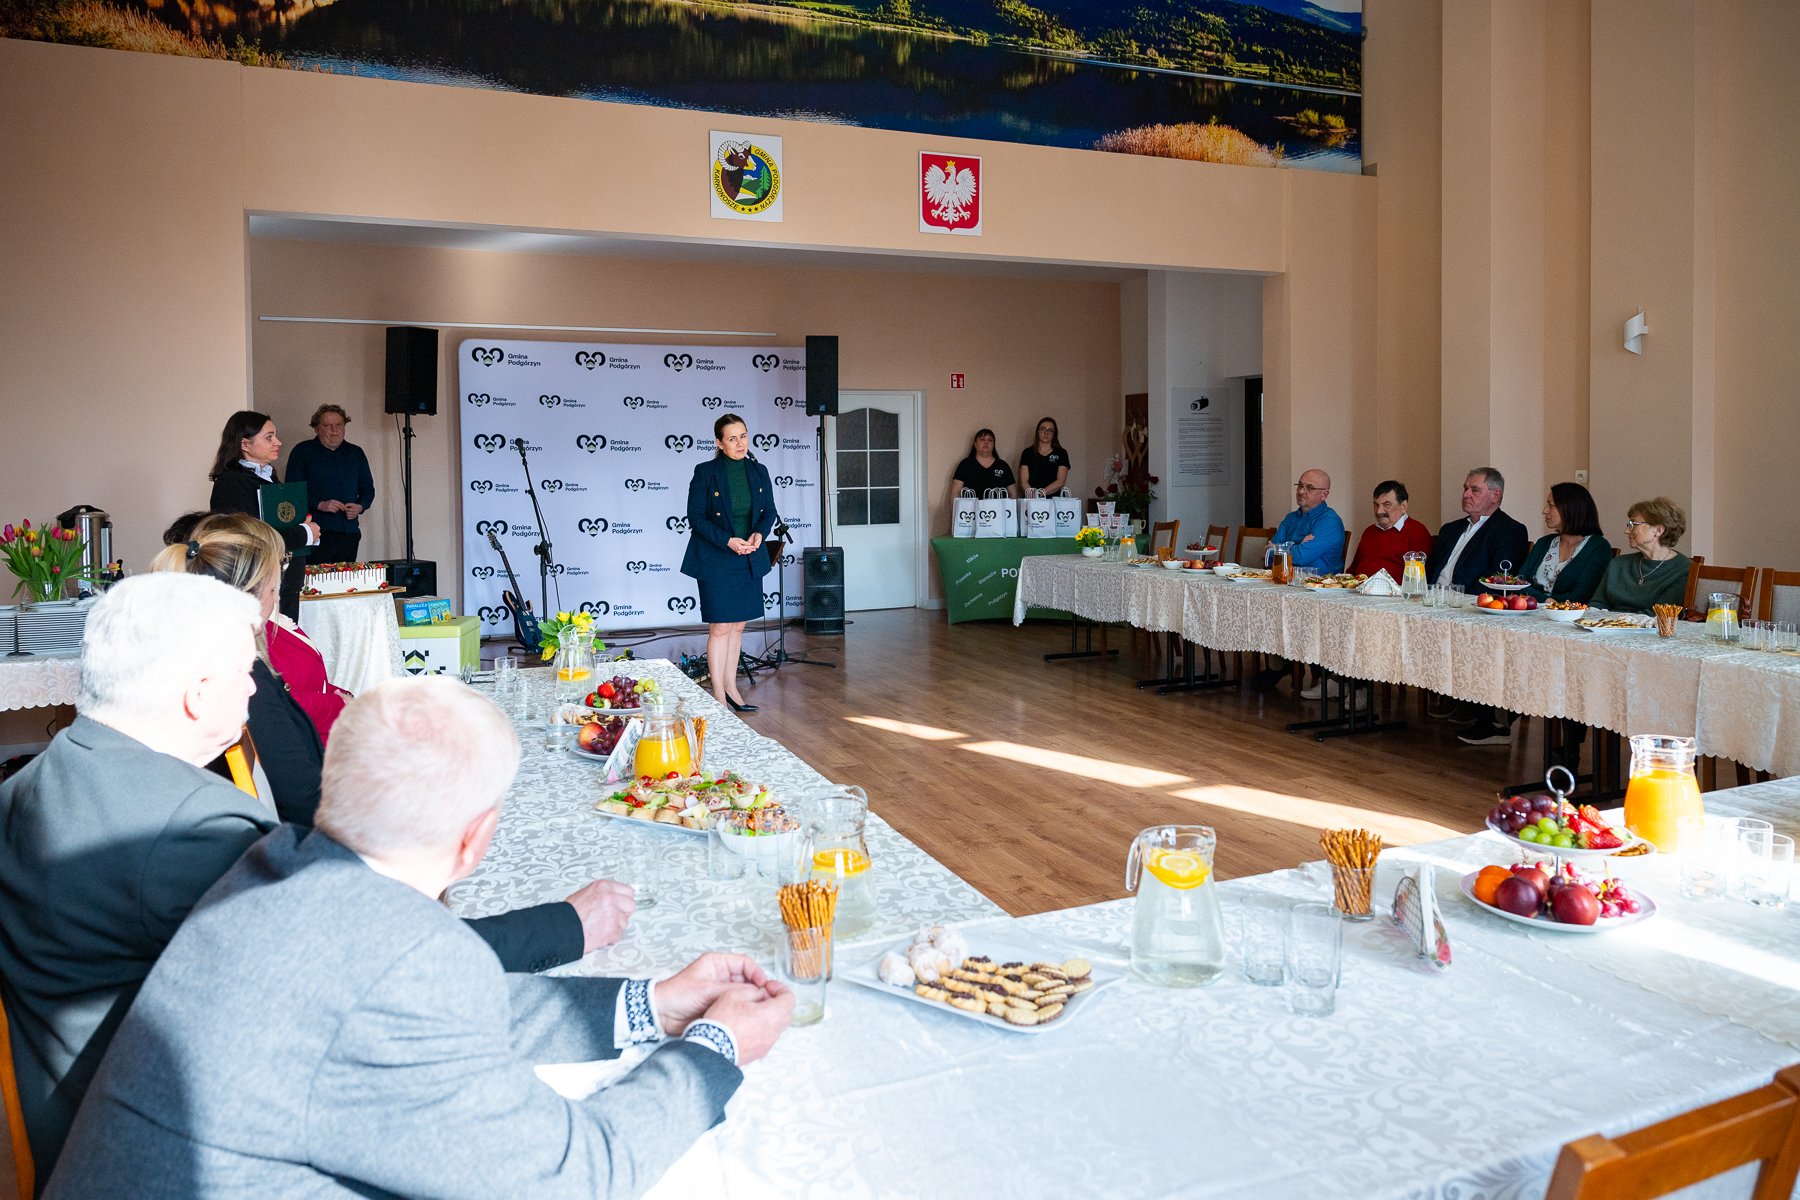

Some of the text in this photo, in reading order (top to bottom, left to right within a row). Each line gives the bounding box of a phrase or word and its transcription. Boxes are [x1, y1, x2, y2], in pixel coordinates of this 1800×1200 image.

[754, 148, 774, 168] GMINA
[714, 168, 740, 210] KARKONOSZE
[508, 360, 542, 368] Podgórzyn
[610, 362, 640, 370] Podgórzyn
[1001, 568, 1020, 578] PO
